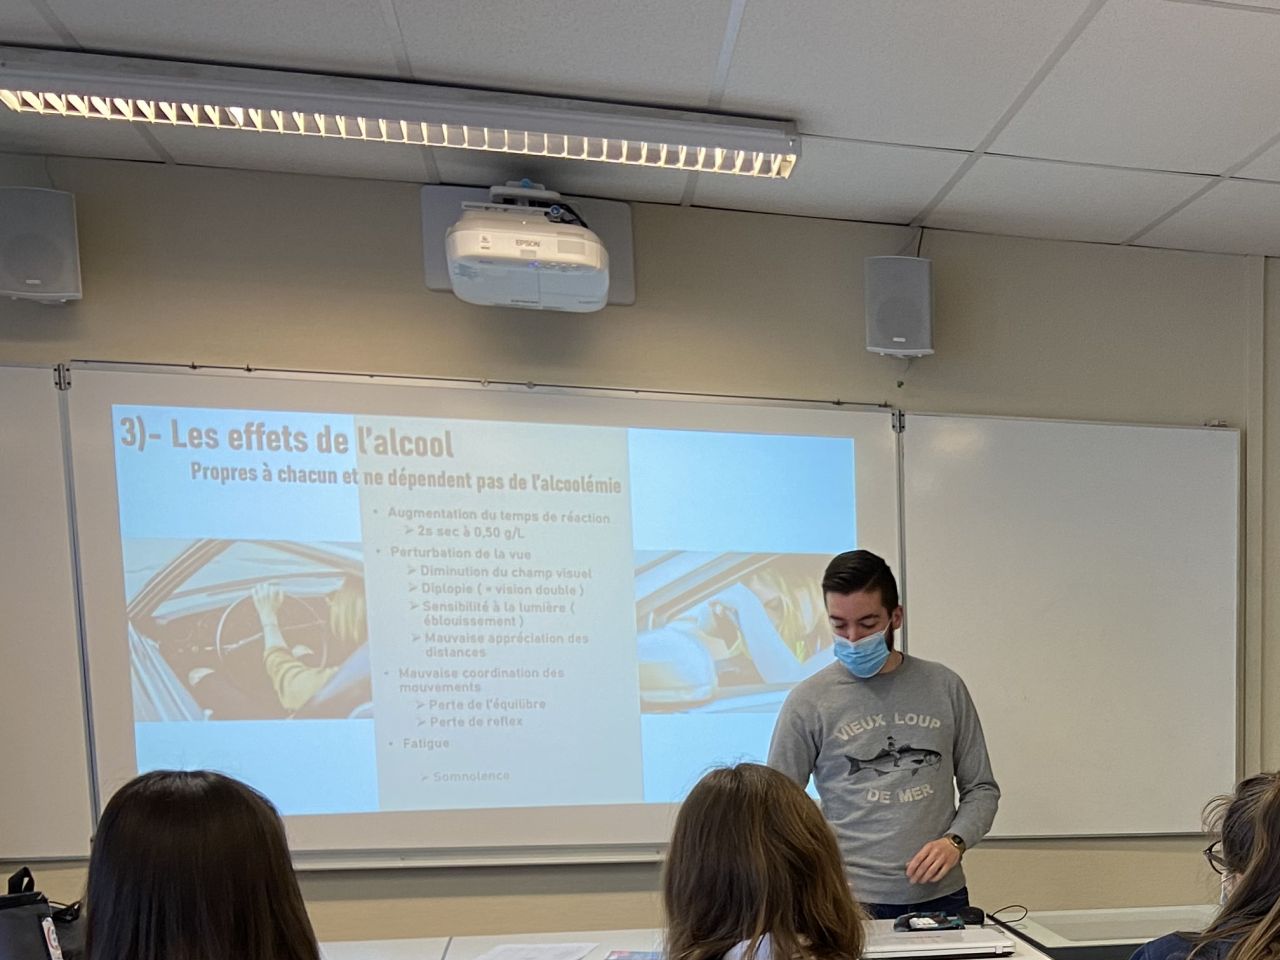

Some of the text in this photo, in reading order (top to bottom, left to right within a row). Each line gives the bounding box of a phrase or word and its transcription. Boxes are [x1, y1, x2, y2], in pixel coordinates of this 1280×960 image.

[515, 239, 541, 248] EPSON
[171, 418, 220, 449] Les
[228, 421, 308, 453] effets
[316, 425, 349, 454] de
[358, 425, 454, 458] l'alcool
[190, 462, 622, 494] Propres à chacun et ne dépendent pas de l'alcoolémie
[387, 506, 611, 524] Augmentation du temps de réaction
[417, 525, 433, 537] 2s
[437, 527, 460, 537] sec
[463, 525, 471, 538] à
[504, 527, 525, 540] g/L
[391, 546, 532, 560] Perturbation de la vue
[420, 565, 592, 581] Diminution du champ visuel
[421, 582, 576, 597] Diplopie vision double
[422, 601, 566, 613] Sensibilité à la lumière
[424, 615, 516, 626] éblouissement
[425, 633, 589, 646] Mauvaise appréciation des
[425, 647, 486, 658] distances
[399, 668, 565, 679] Mauvaise coordination des
[400, 682, 481, 693] mouvements
[429, 698, 546, 712] Perte de l'équilibre
[430, 716, 523, 727] Perte de reflex
[834, 712, 942, 741] VIEUX LOUP
[403, 739, 450, 751] Fatigue
[433, 771, 510, 783] Somnolence
[867, 784, 934, 804] DE MER
